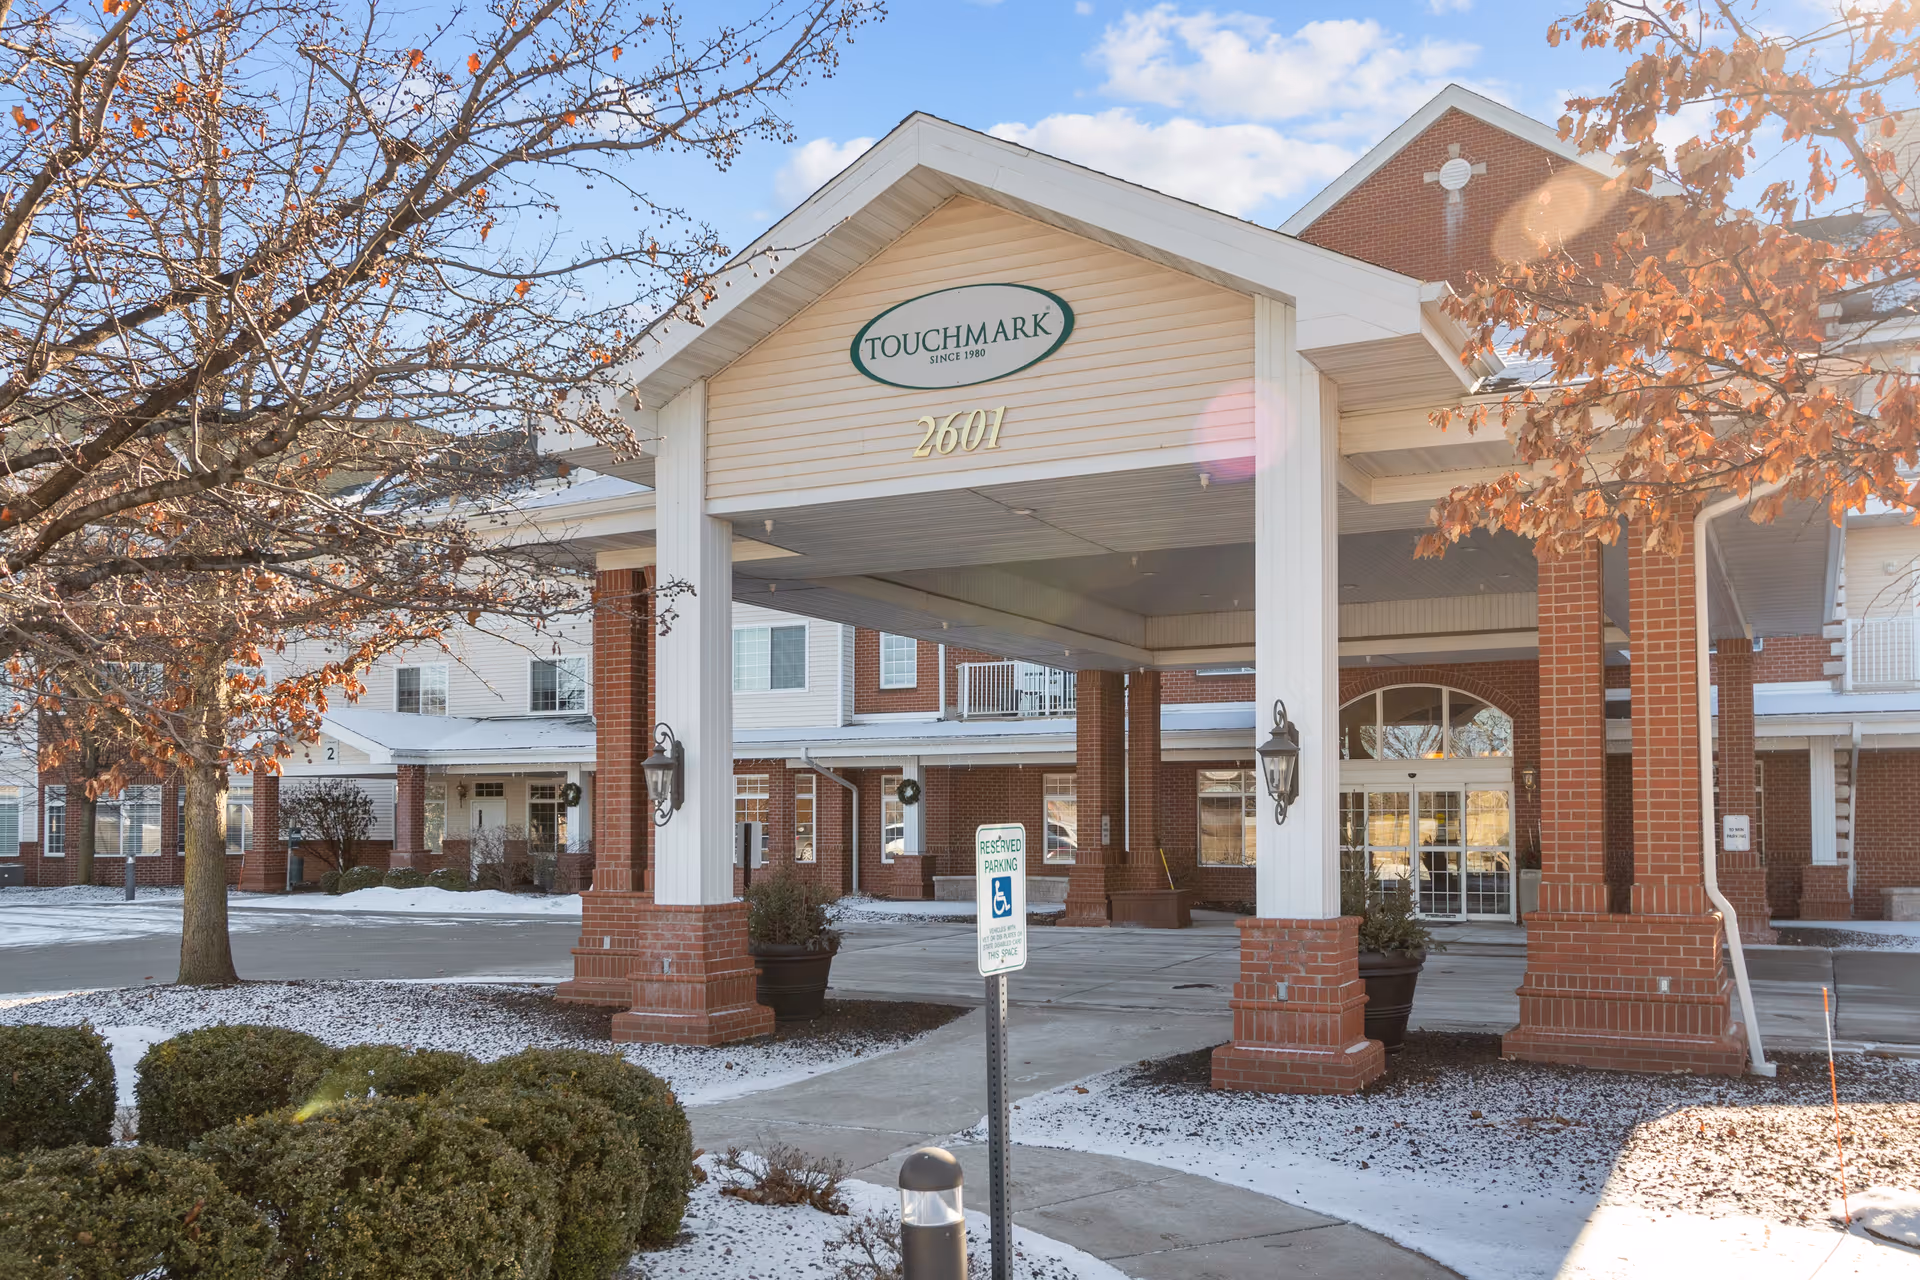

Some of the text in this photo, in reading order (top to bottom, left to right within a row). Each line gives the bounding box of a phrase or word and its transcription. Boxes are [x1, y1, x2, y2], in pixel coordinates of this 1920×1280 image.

[865, 312, 1052, 360] TOUCHMARK
[930, 348, 986, 364] SINCE 1980
[912, 405, 1007, 458] 2601
[327, 747, 335, 760] 2
[980, 838, 1021, 855] RESERVED
[985, 858, 1017, 873] PARKING
[988, 947, 1018, 960] THIS SPACE
